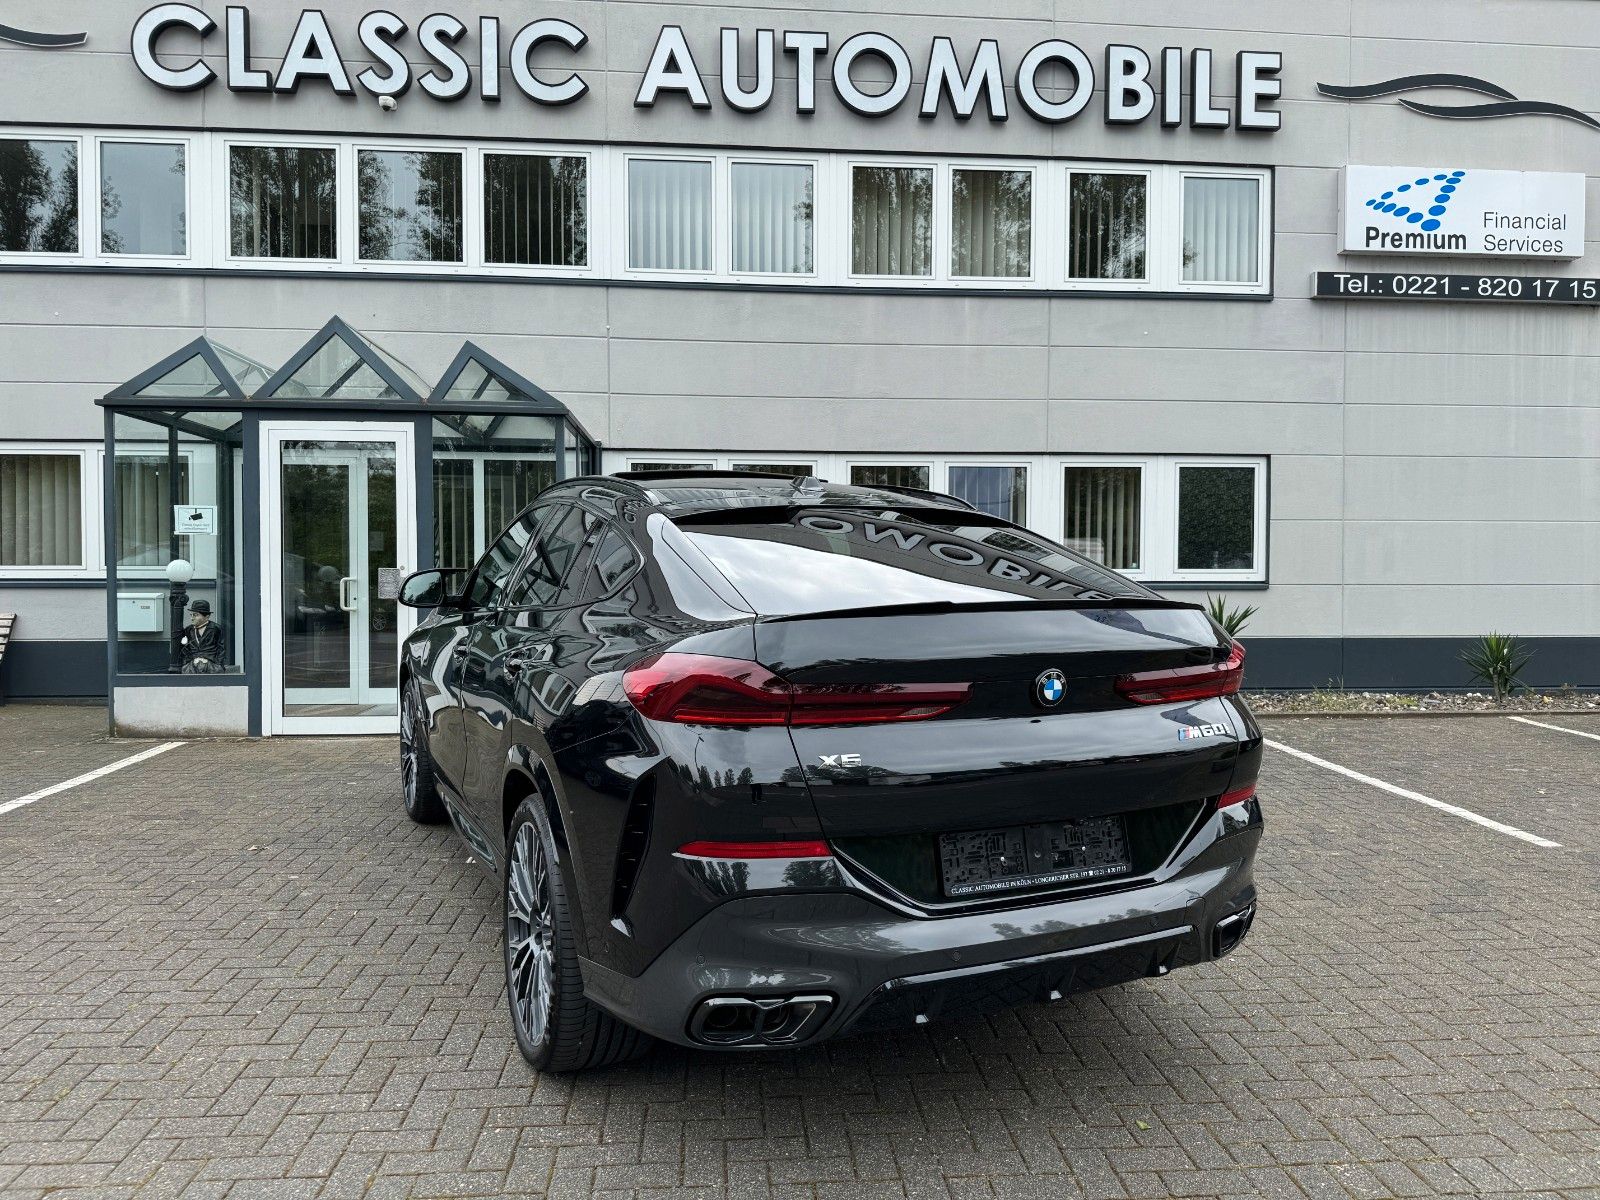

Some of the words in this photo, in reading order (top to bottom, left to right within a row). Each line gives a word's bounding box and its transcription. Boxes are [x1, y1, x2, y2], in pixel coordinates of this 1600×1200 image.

[131, 2, 590, 105] CLASSIC
[634, 25, 1282, 132] AUTOMOBILE
[1483, 211, 1566, 231] Financial
[1365, 226, 1467, 250] Premium
[1483, 234, 1563, 253] Services
[1334, 274, 1383, 294] Tel.:
[1392, 275, 1450, 295] 0221
[1477, 277, 1522, 297] 820
[1532, 279, 1560, 297] 17
[1569, 280, 1596, 299] 15
[951, 886, 974, 895] CLASSIC
